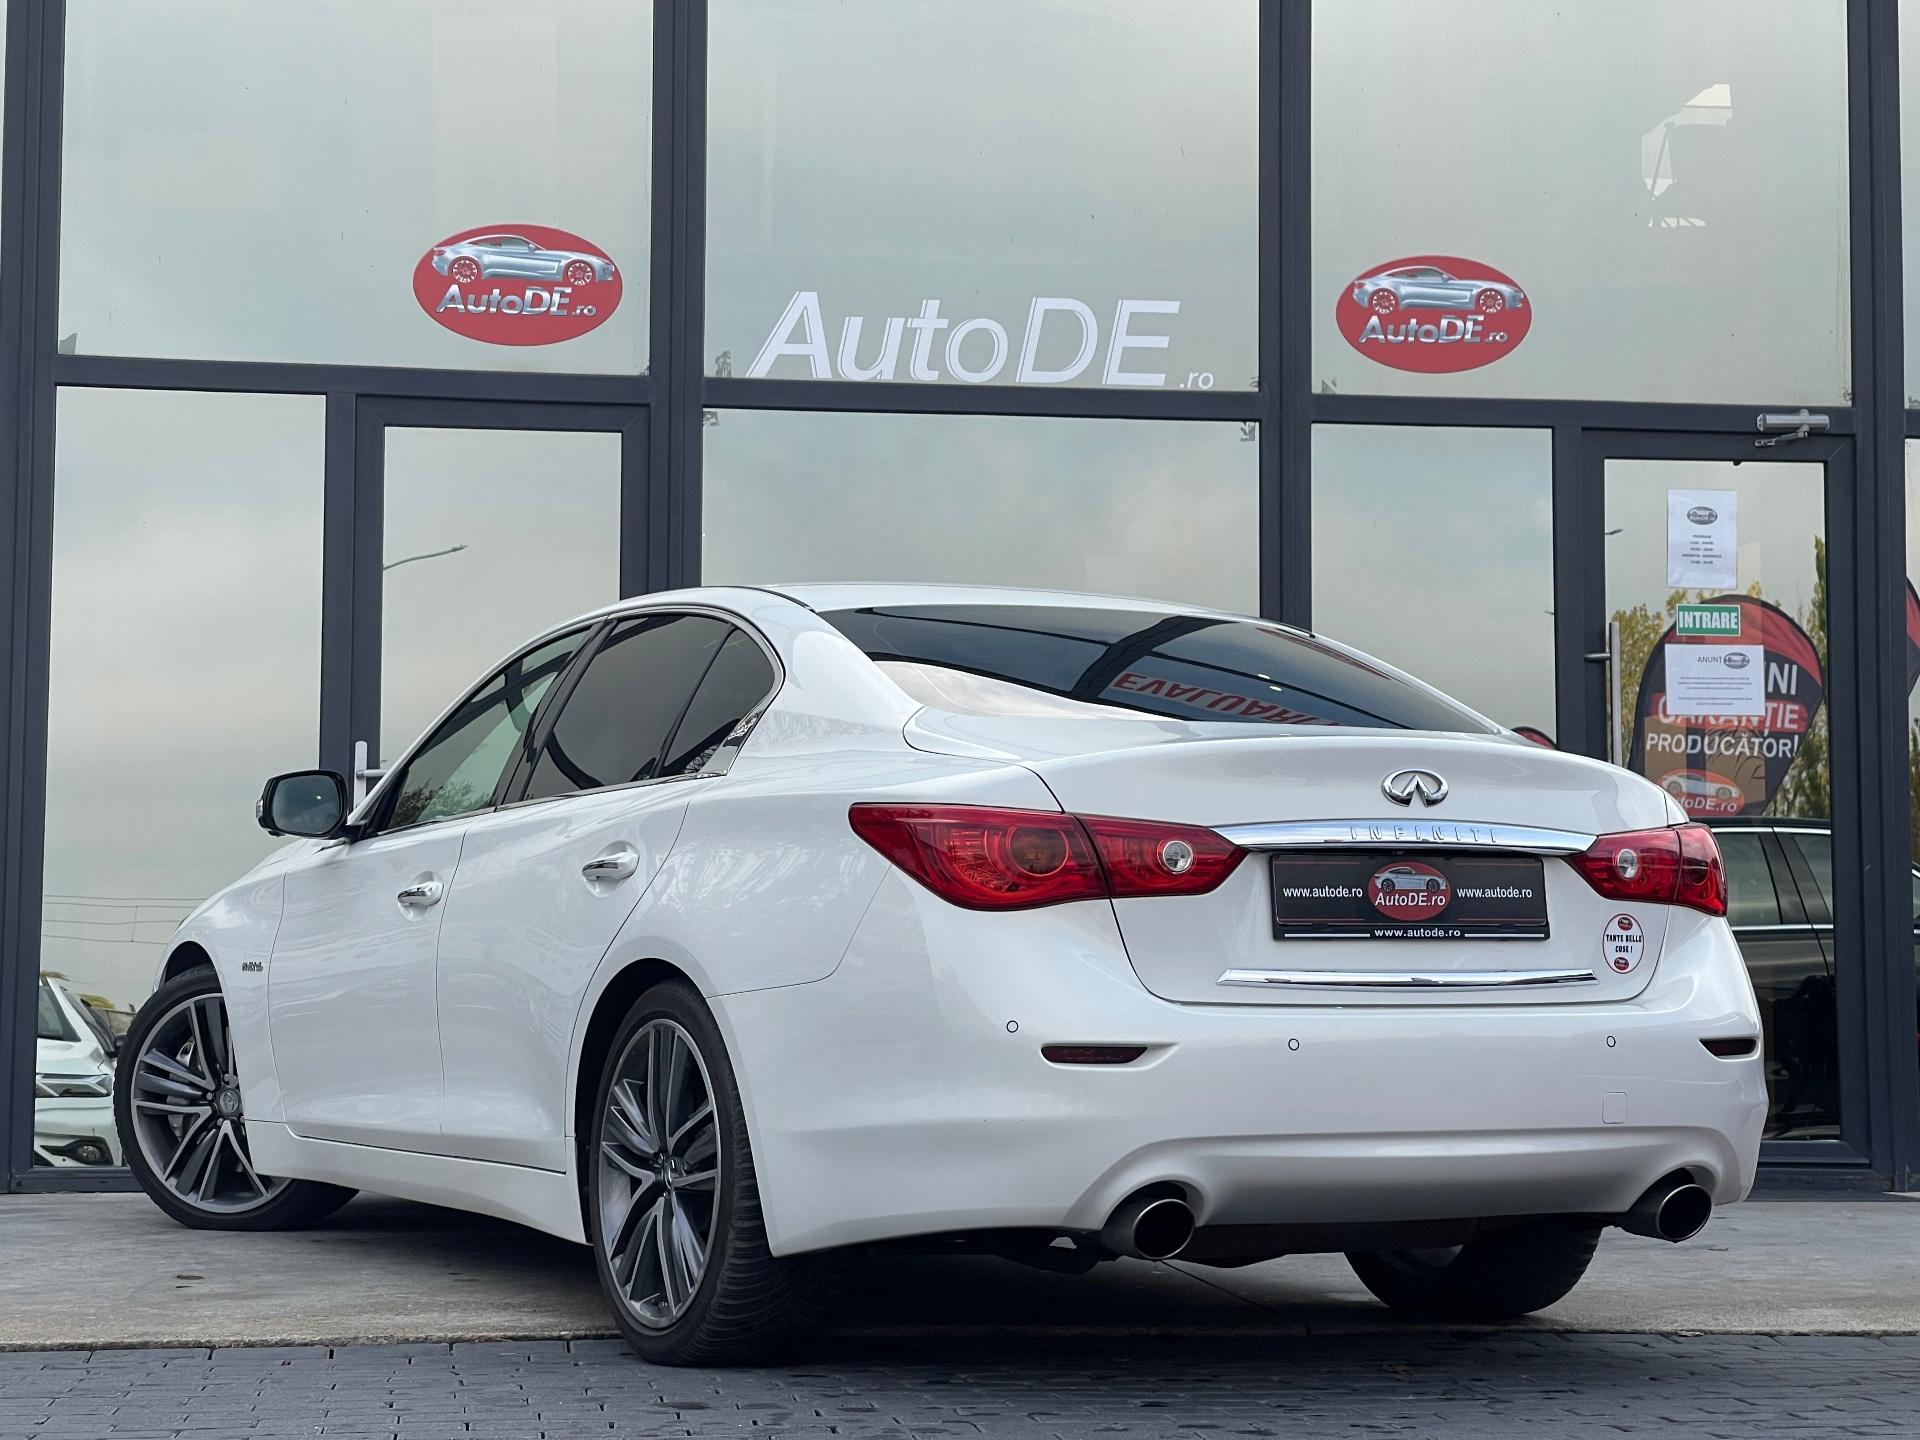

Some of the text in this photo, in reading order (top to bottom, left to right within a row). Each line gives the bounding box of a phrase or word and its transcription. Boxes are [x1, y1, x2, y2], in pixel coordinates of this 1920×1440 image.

[1678, 610, 1738, 630] INTRARE
[1765, 661, 1798, 696] NI
[1646, 733, 1798, 759] PRODUCĂTOR!
[1677, 796, 1737, 812] toDE.ro
[1350, 825, 1497, 843] INFINITI
[1283, 885, 1363, 898] www.autode.ro
[1374, 892, 1447, 906] AutoDE.ro
[1457, 886, 1533, 899] www.autode.ro
[1374, 928, 1461, 938] www.autode.ro
[1606, 934, 1642, 943] TANTE BELLE
